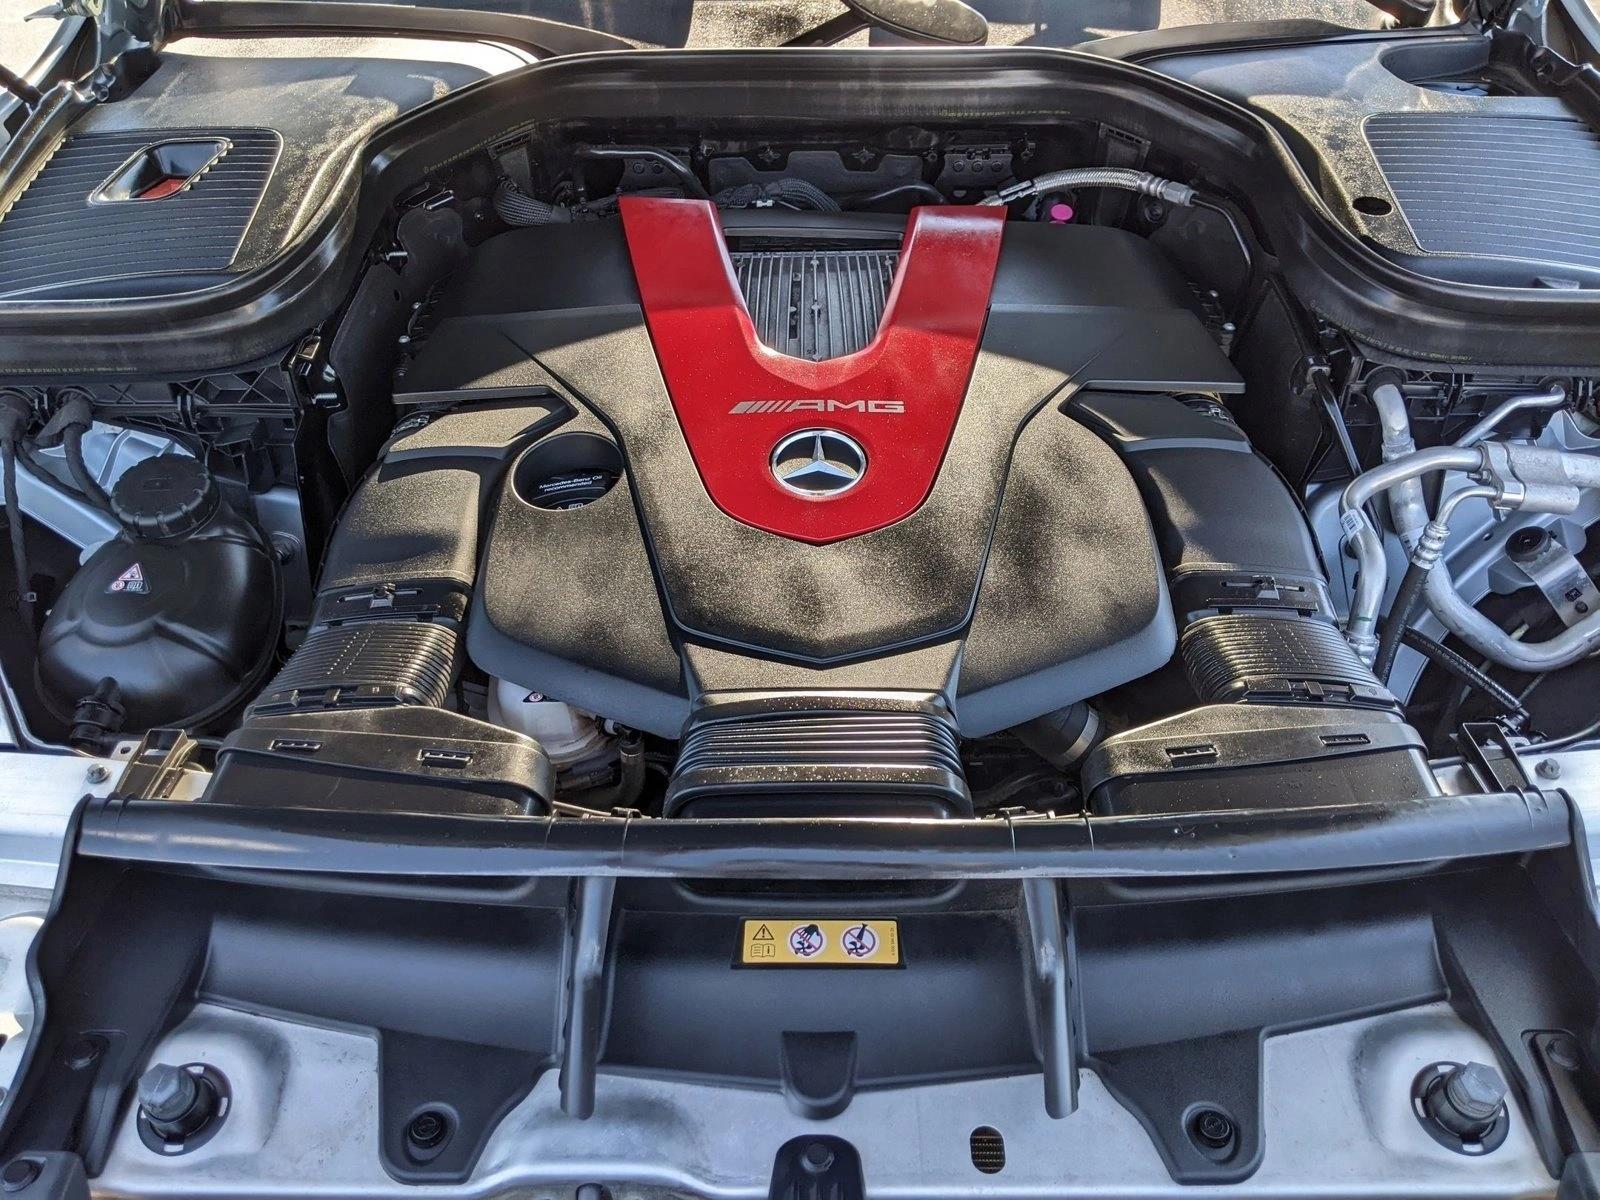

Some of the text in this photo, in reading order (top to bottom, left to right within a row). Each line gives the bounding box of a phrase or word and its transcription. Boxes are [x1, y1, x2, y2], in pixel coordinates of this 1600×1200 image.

[784, 399, 905, 414] AMG
[539, 477, 591, 489] Mercedes-Benz
[544, 480, 592, 492] recommended
